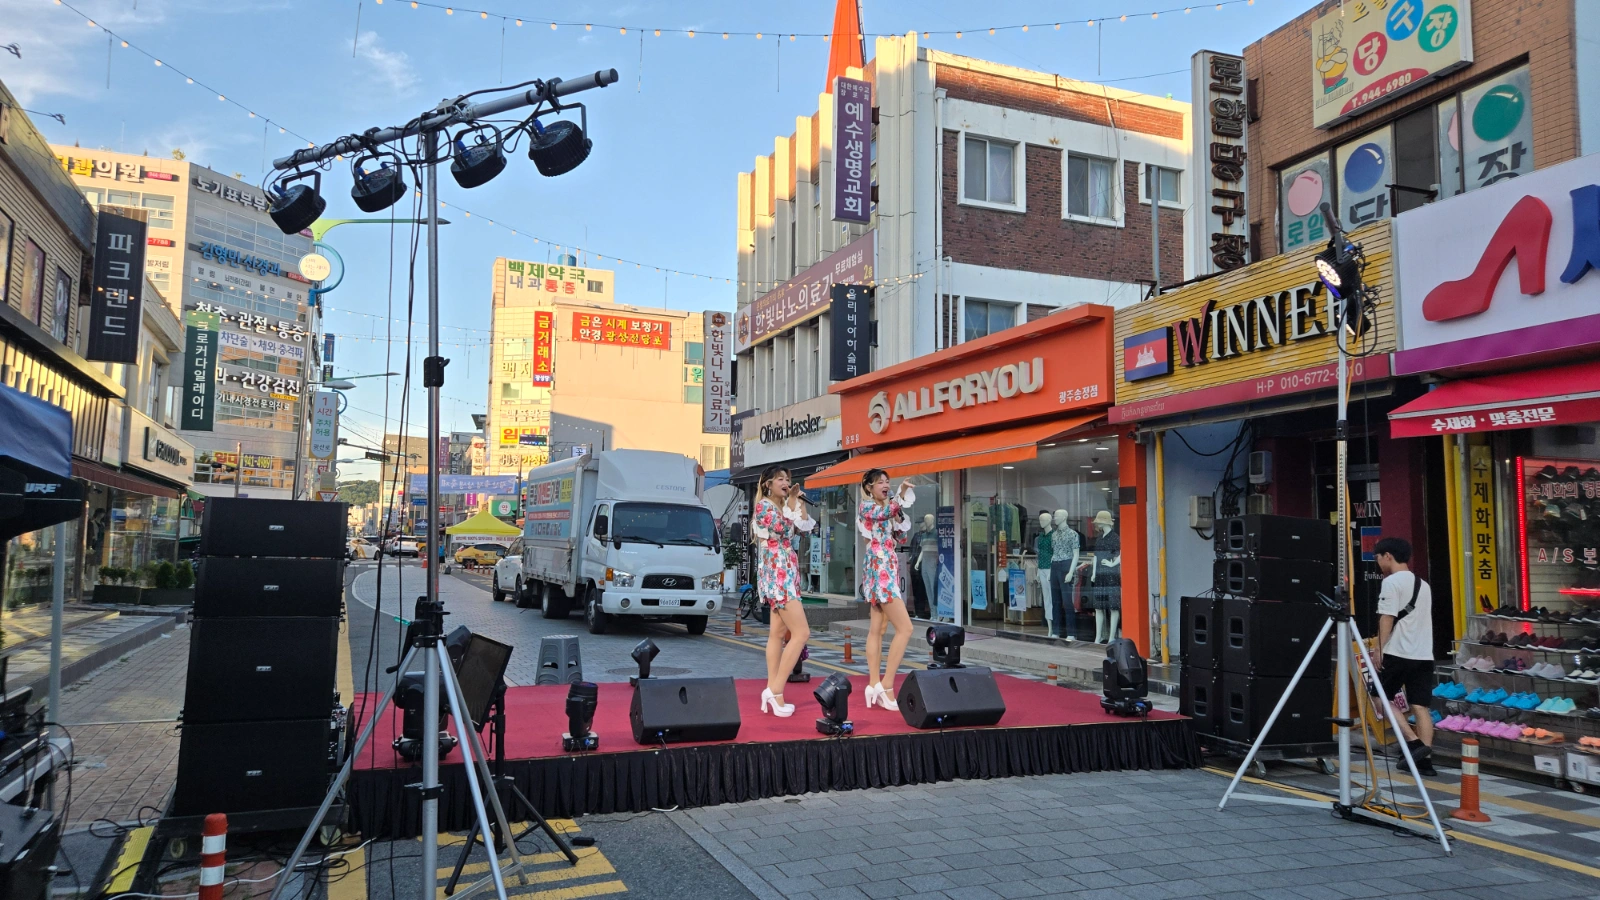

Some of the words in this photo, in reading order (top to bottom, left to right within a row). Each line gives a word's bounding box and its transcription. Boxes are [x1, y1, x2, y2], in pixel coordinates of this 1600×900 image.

[1351, 72, 1412, 108] T.944-6980
[844, 102, 864, 217] 예수생명교회
[508, 261, 585, 283] 백제약국
[835, 249, 863, 275] 무료체험실
[103, 233, 134, 336] 파크랜드
[755, 271, 834, 335] 한빛나노의료기
[580, 328, 601, 341] 안경
[606, 318, 627, 330] 시계
[631, 320, 663, 333] 보청기
[847, 288, 857, 377] 올리비아하슬러
[537, 315, 550, 372] 금거래소
[192, 321, 210, 420] 크로커다일레이디
[711, 330, 724, 425] 한빛나노의료기
[892, 357, 1044, 423] ALLFORYOU
[1059, 384, 1098, 404] 광주송정점
[316, 420, 331, 429] 주차
[317, 408, 332, 416] 시간
[315, 428, 330, 437] 허용
[760, 422, 784, 445] Olivia
[785, 413, 821, 439] Hassler
[1529, 482, 1579, 499] 수제화의
[1583, 548, 1598, 565] 보
